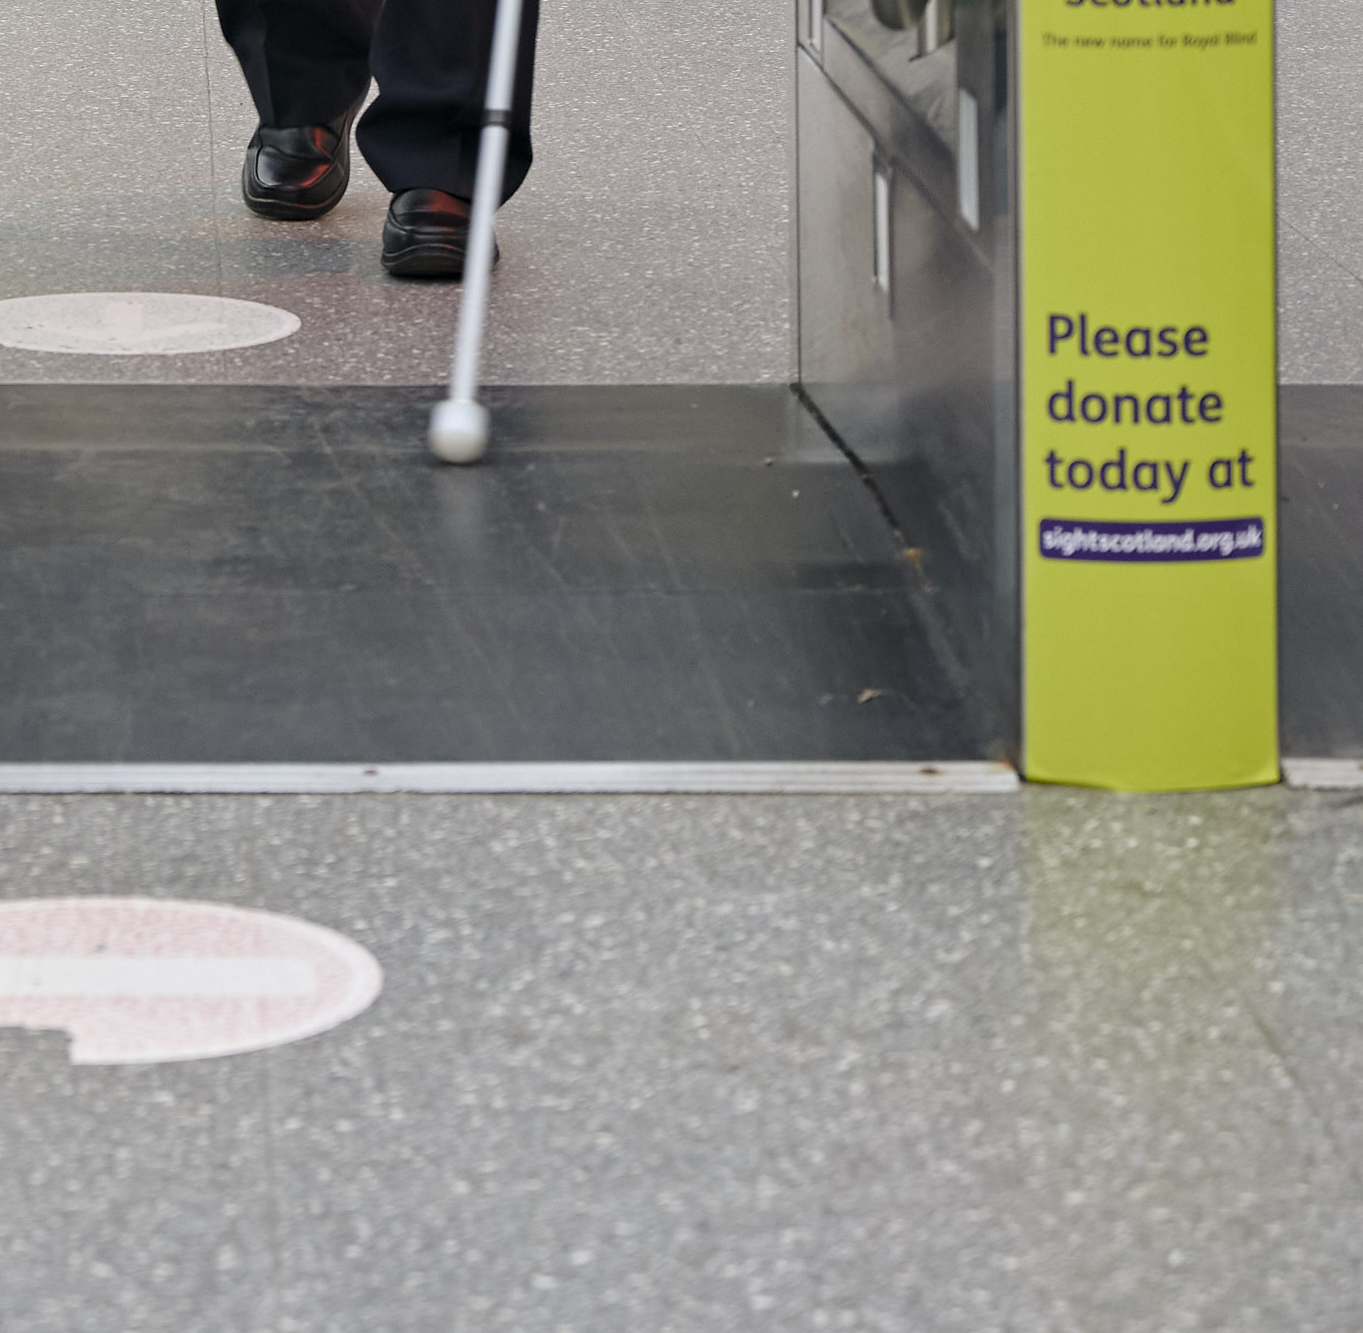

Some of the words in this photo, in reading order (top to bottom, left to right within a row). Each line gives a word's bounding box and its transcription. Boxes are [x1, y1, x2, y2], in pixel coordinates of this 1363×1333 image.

[1048, 312, 1209, 357] Please
[1048, 379, 1224, 424] donate
[1045, 447, 1192, 505] today
[1208, 448, 1255, 489] at
[1043, 524, 1263, 557] sightscotland.org.uk
